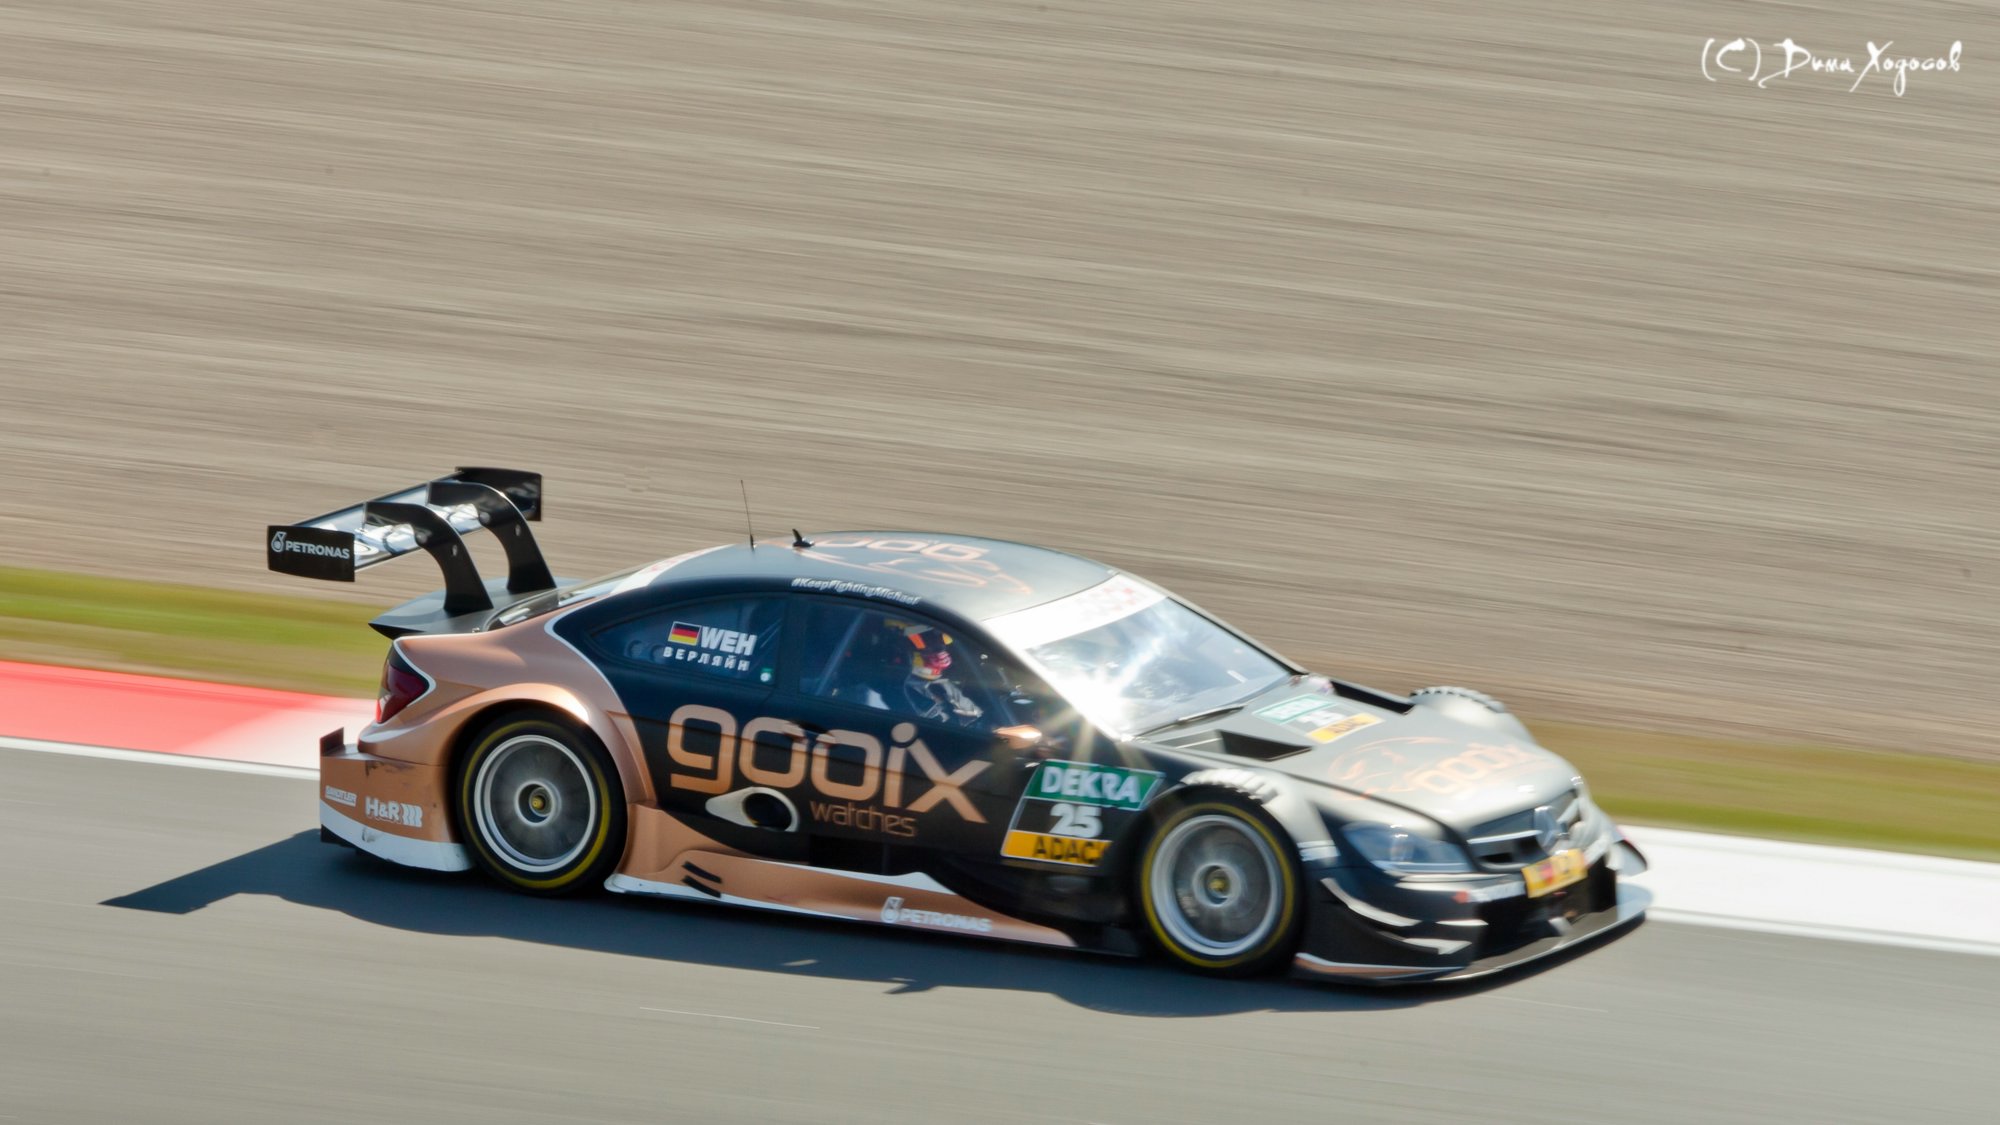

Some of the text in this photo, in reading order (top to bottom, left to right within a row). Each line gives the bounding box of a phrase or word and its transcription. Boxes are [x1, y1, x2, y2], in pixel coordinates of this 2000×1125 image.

[285, 540, 351, 560] PETRONAS
[700, 625, 758, 656] WEH
[663, 646, 751, 672] ВЕРЛЯЙН
[667, 704, 994, 824] gooix
[1041, 765, 1142, 803] DEKRA
[365, 796, 401, 821] H&R
[809, 800, 918, 838] watches
[1049, 803, 1104, 839] 25
